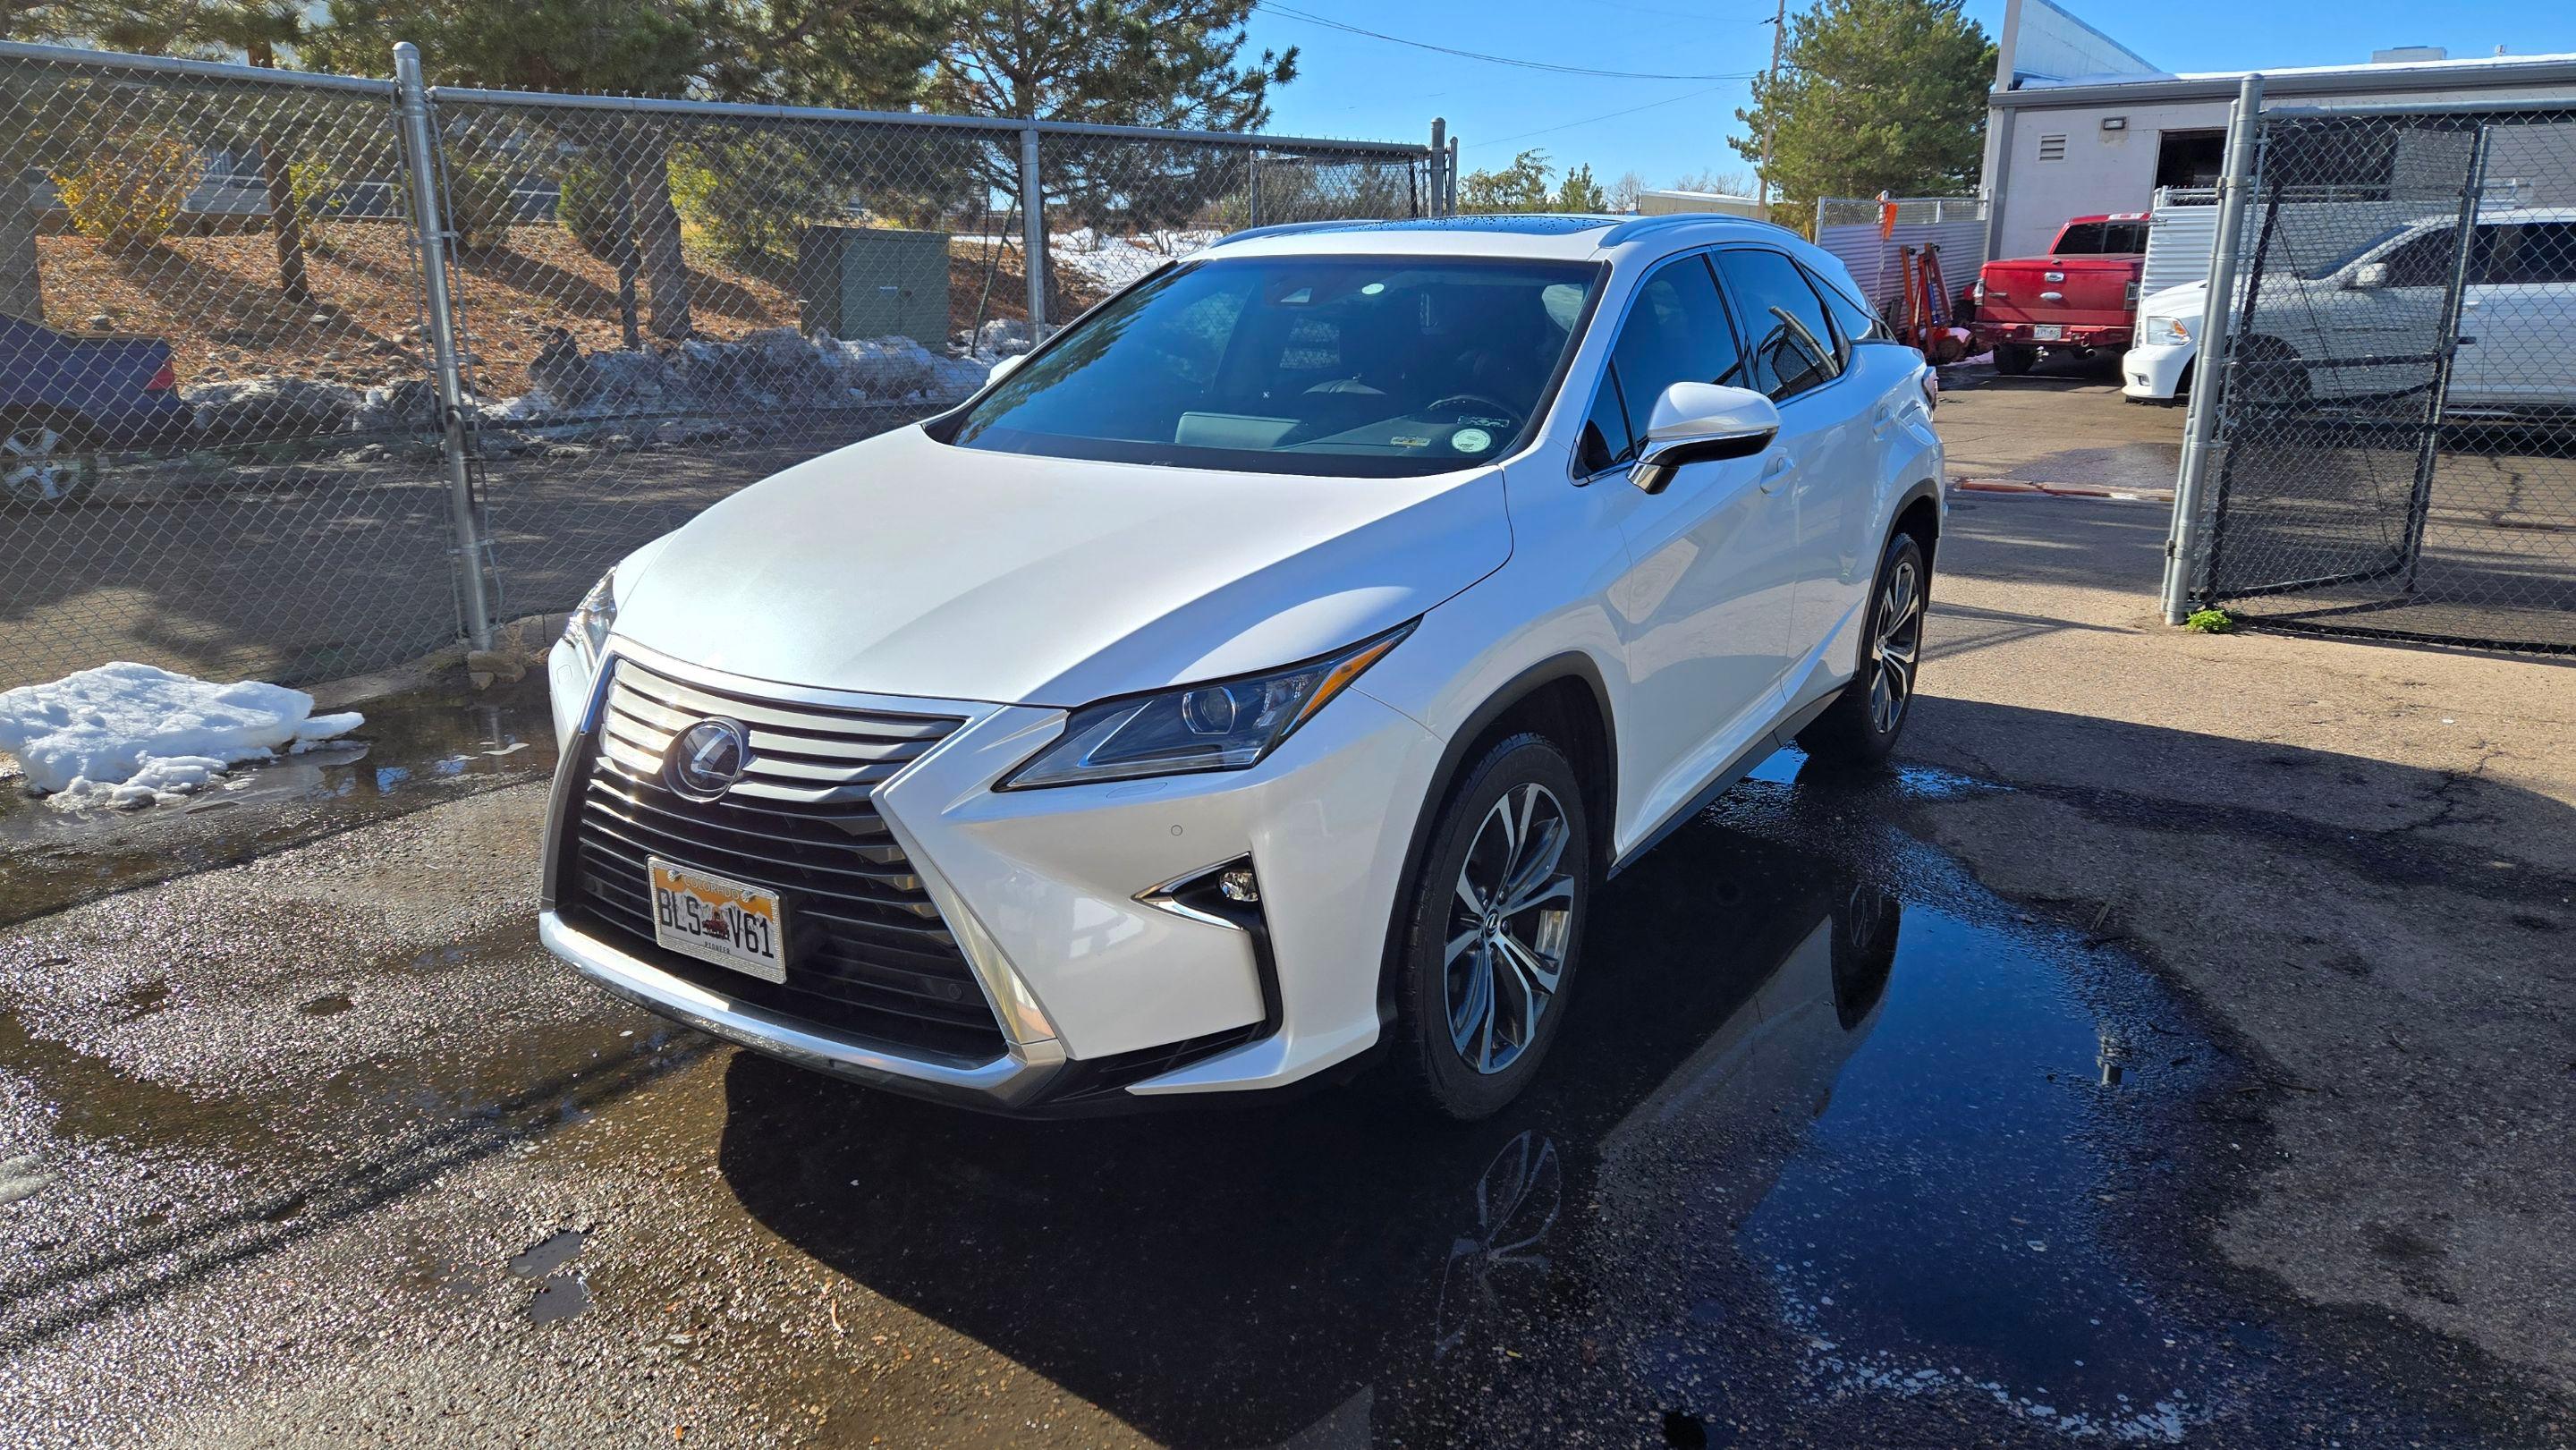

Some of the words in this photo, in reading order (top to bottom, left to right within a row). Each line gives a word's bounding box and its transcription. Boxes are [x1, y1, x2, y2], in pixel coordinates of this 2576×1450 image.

[683, 876, 740, 900] COLORADO
[657, 887, 700, 936] BLS
[728, 907, 775, 959] V61
[704, 941, 730, 954] PIONEER
